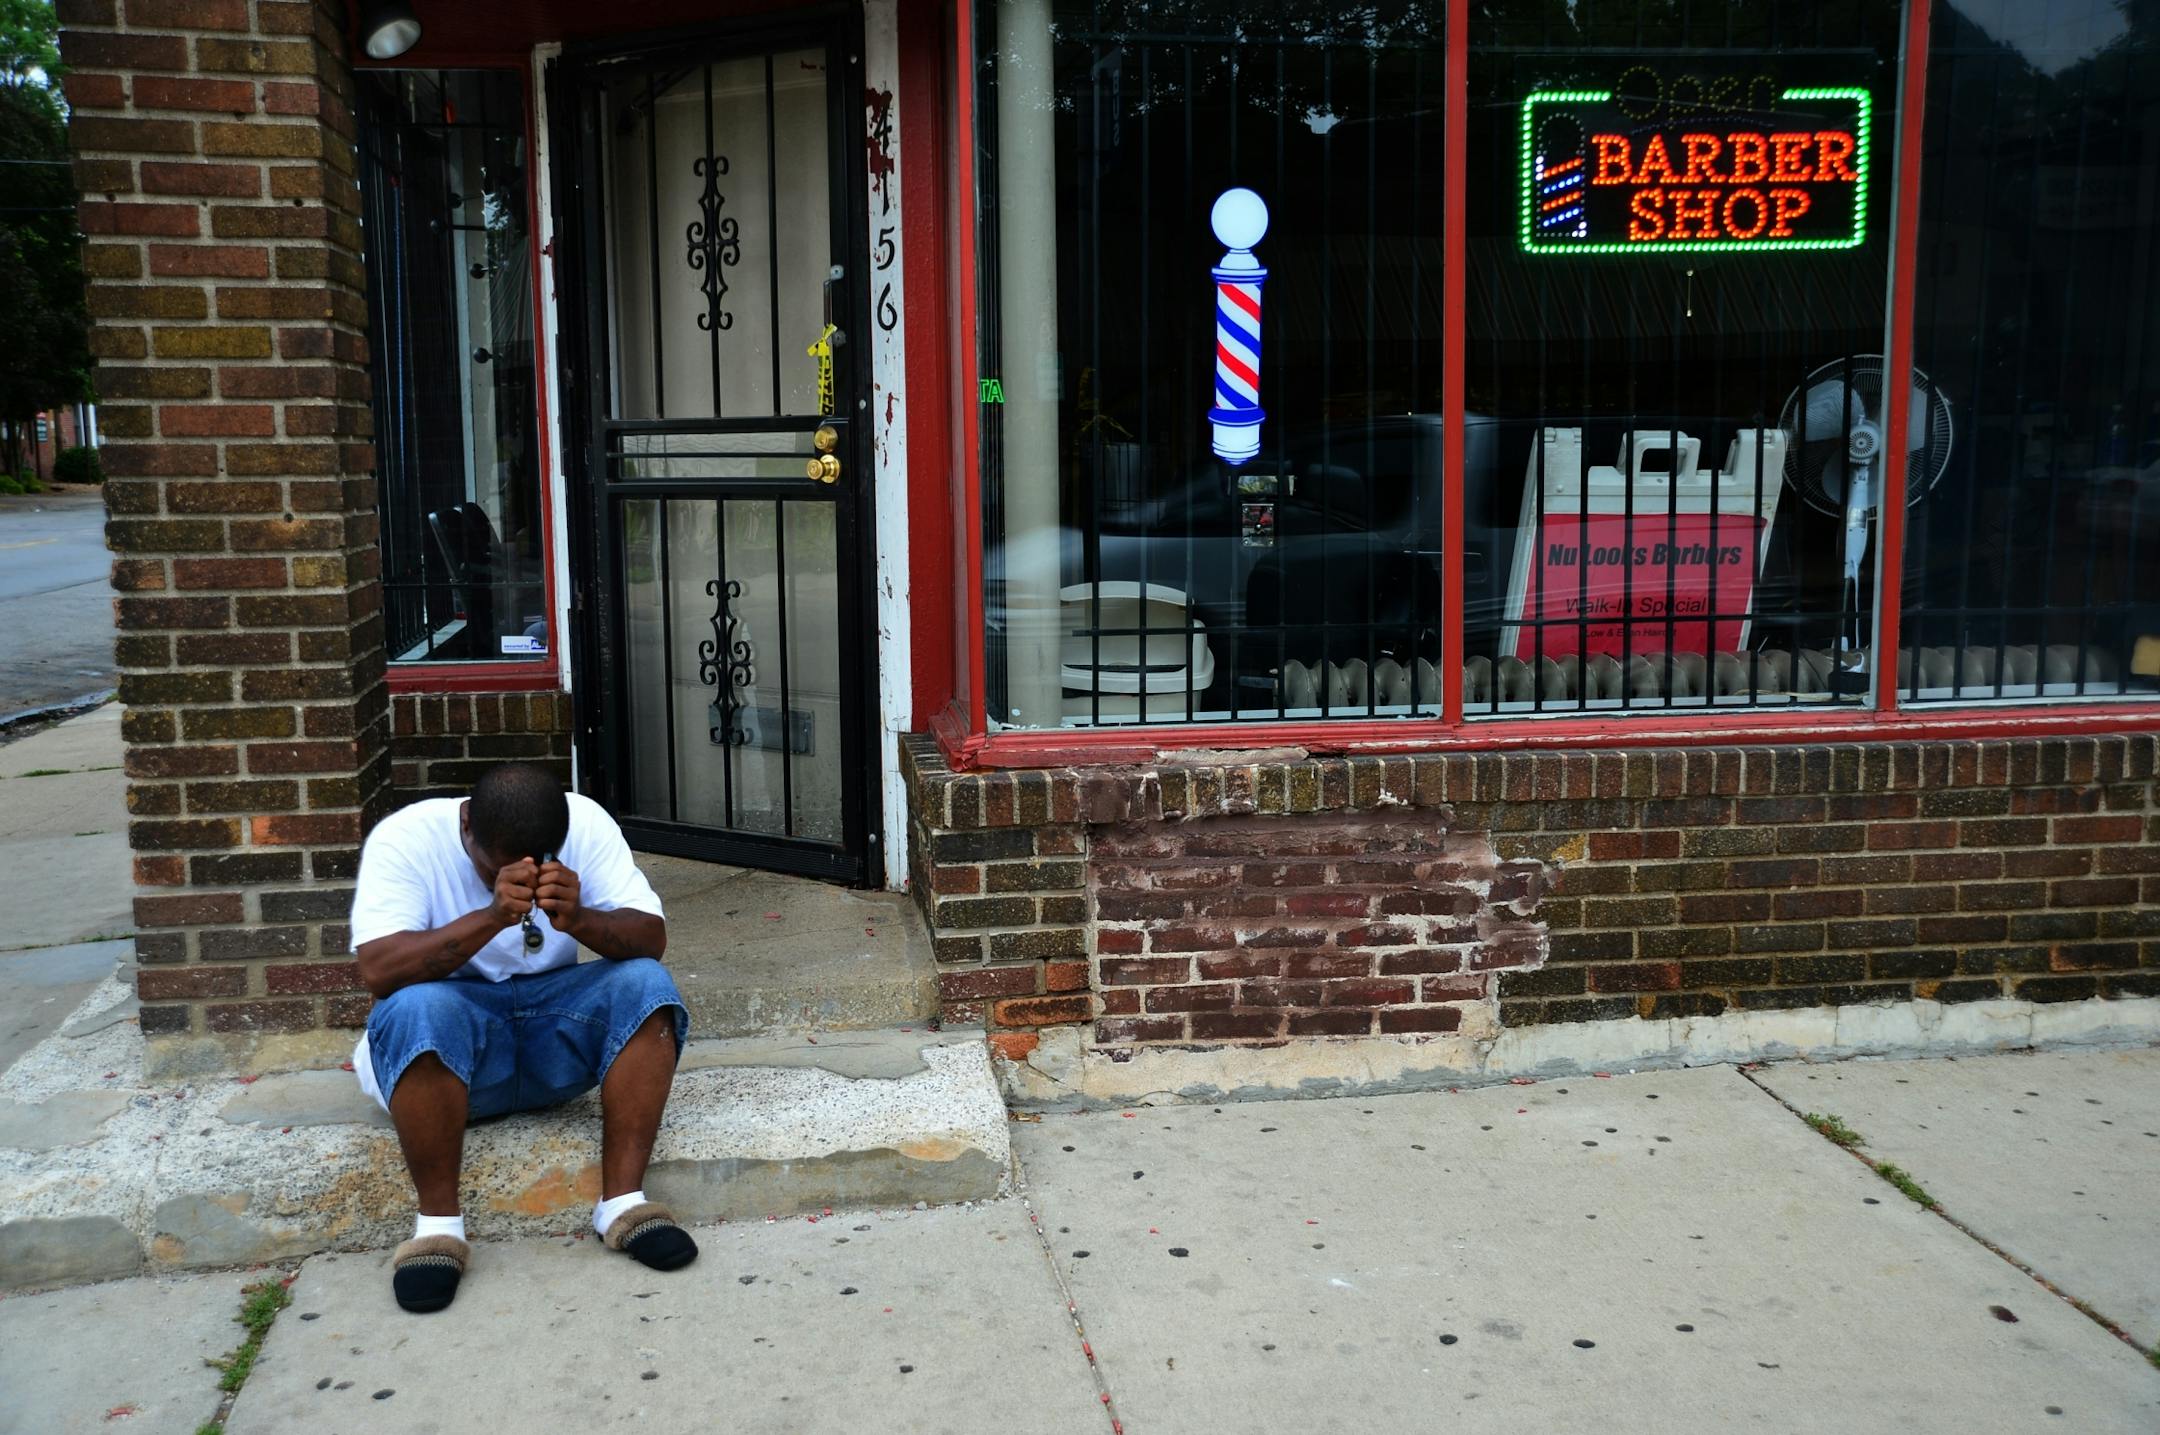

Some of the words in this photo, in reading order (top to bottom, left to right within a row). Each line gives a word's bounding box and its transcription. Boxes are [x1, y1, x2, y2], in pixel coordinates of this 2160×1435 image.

[1616, 65, 1777, 131] Open
[1591, 131, 1859, 185] BARBER
[1629, 187, 1812, 241] SHOP
[1547, 543, 1578, 566] Nu
[1581, 543, 1648, 566] Loos
[1566, 597, 1632, 614] Walk-I
[1639, 597, 1706, 616] Spcial
